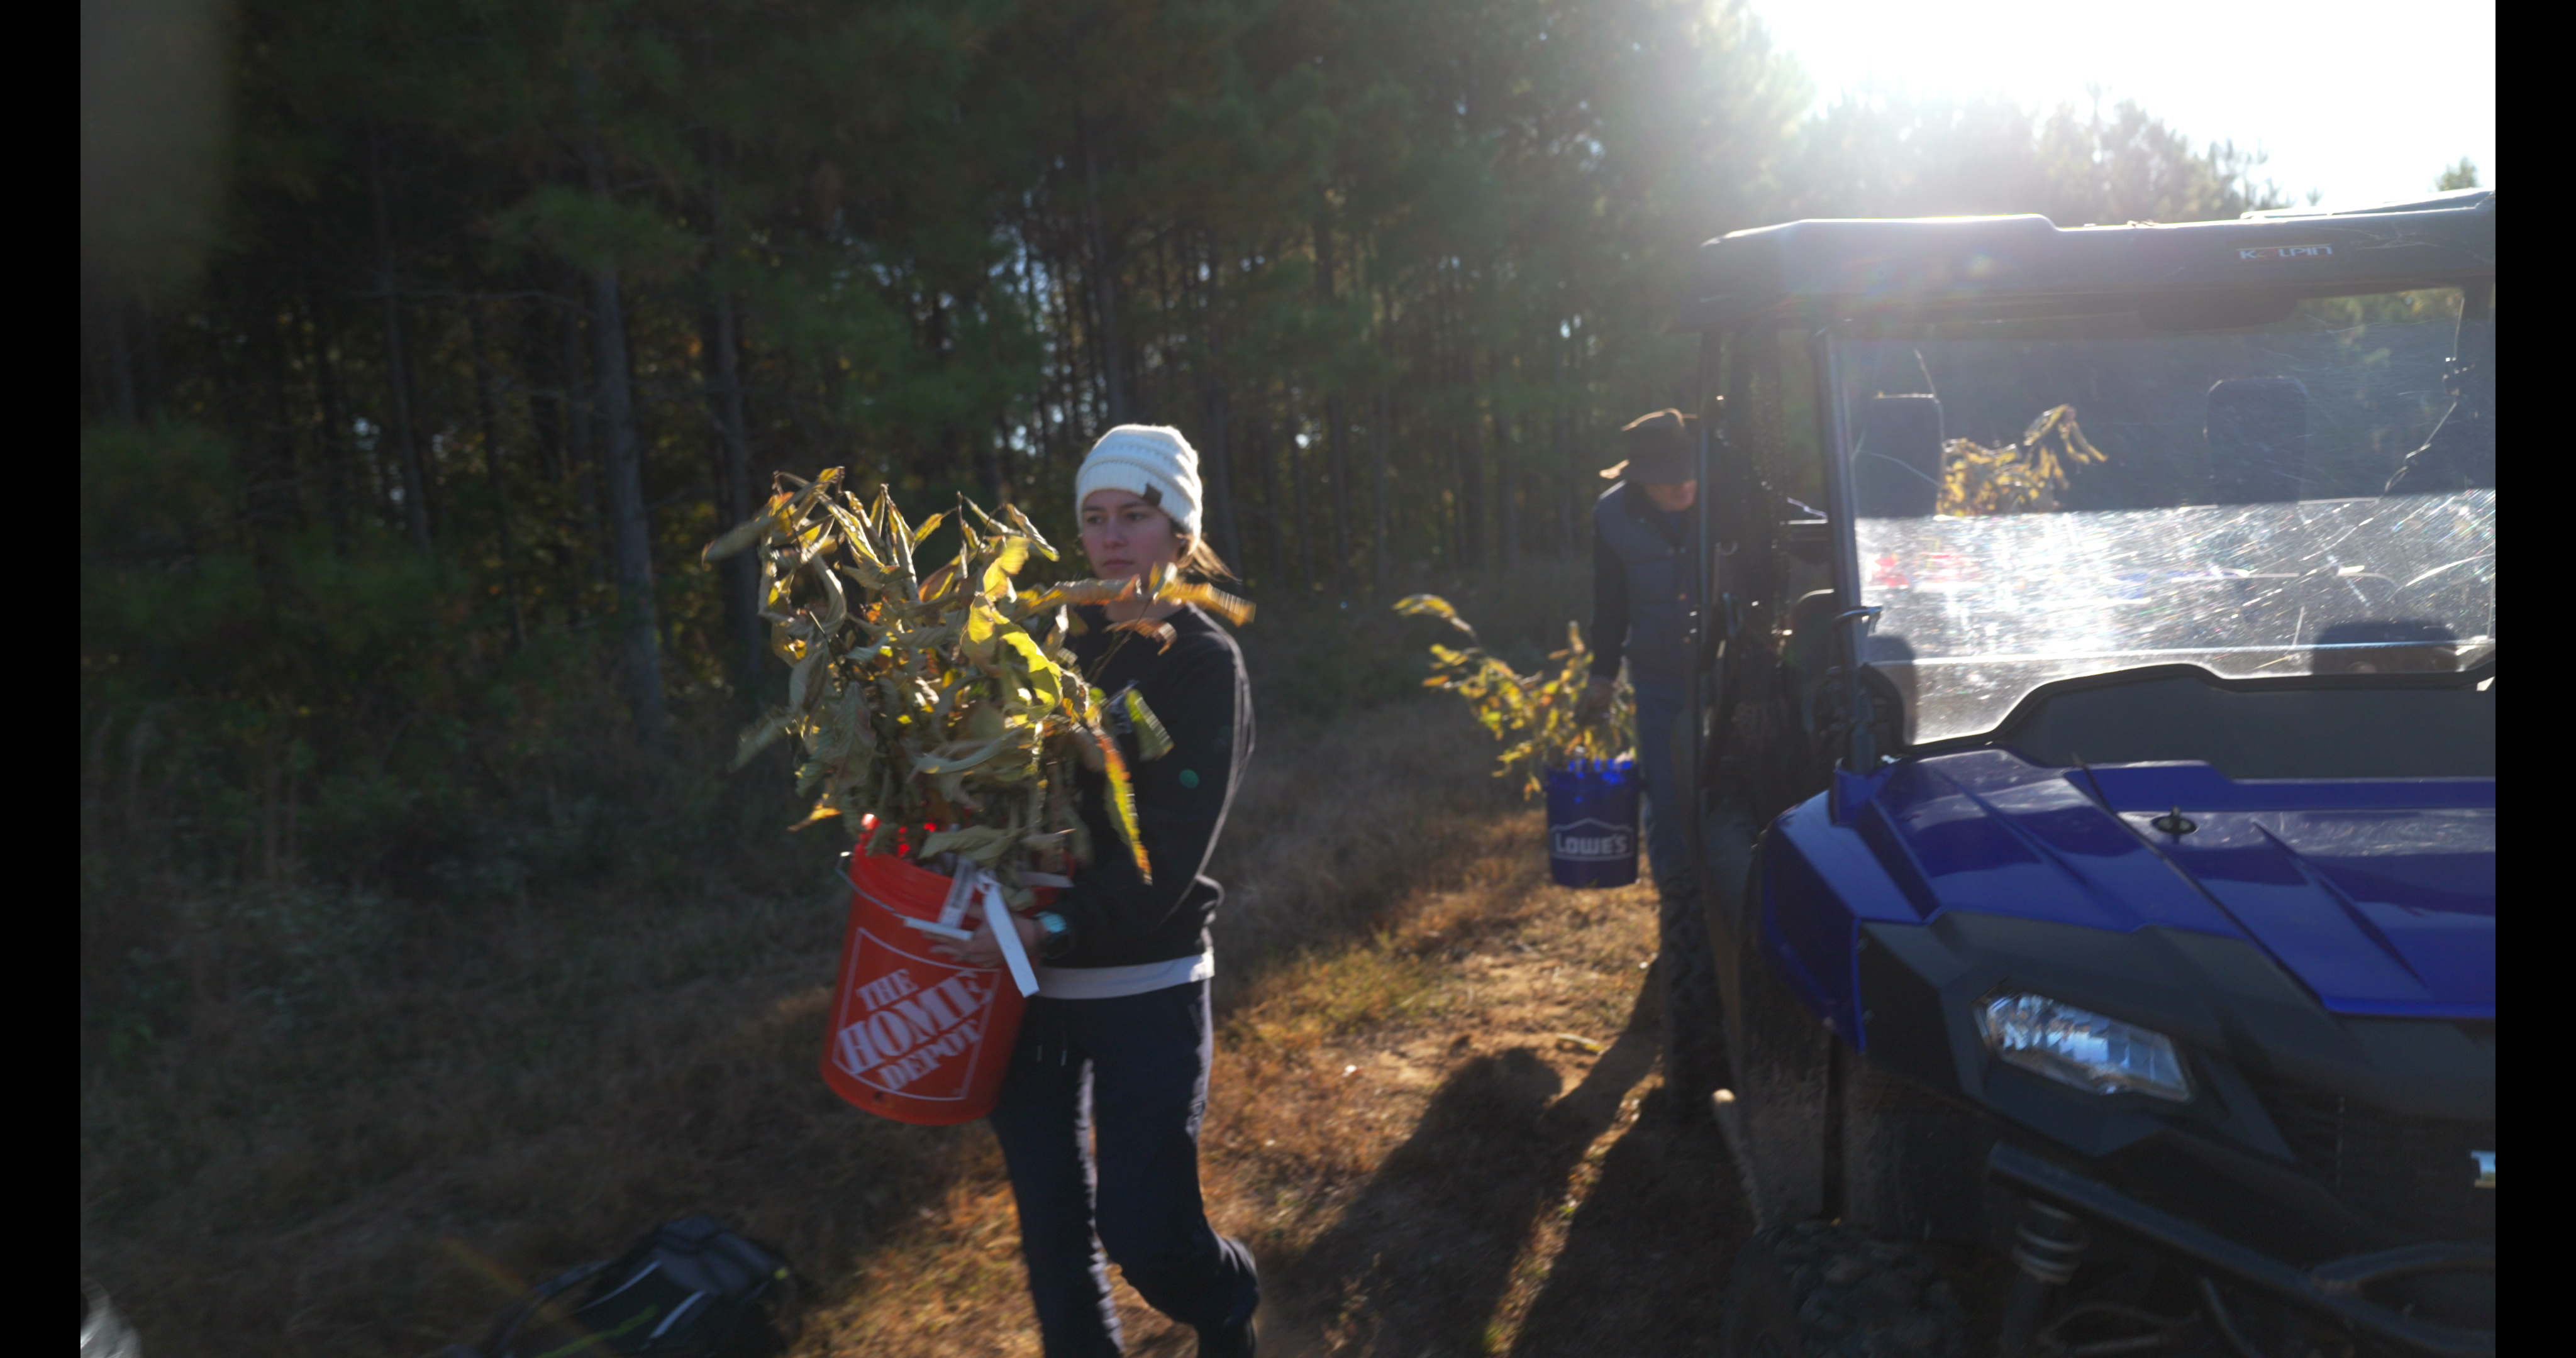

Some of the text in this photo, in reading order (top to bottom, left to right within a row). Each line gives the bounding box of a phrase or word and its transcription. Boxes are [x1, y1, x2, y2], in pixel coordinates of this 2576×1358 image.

[1555, 833, 1627, 855] LOWE'S
[857, 969, 918, 1011] THE
[839, 970, 992, 1076] HOME
[879, 1019, 981, 1091] DEPOT
